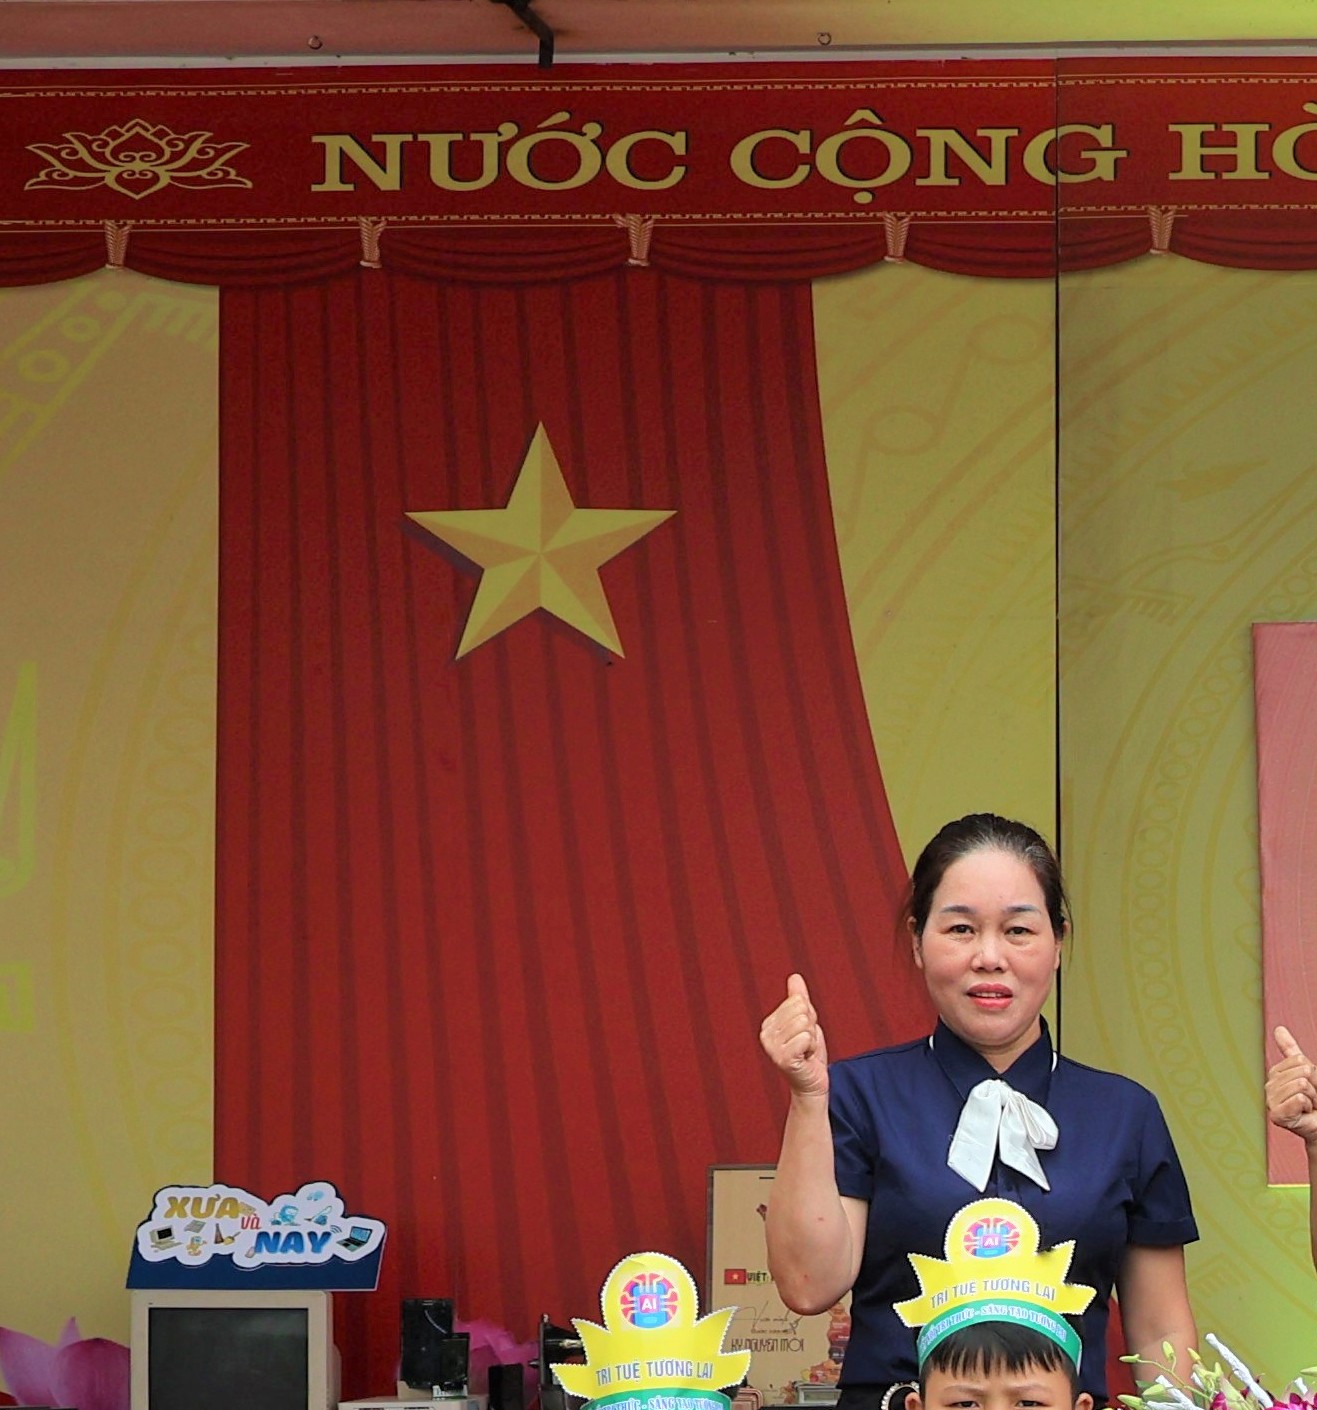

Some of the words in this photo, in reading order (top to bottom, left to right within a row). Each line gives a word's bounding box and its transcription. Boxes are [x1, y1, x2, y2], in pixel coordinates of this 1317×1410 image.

[310, 111, 690, 192] NƯỚC
[728, 108, 1128, 204] CỘNG
[164, 1194, 240, 1219] XƯA
[240, 1214, 262, 1230] và
[253, 1231, 332, 1254] NAY
[984, 1236, 1000, 1247] AI
[1035, 1283, 1056, 1302] LAI
[641, 1298, 658, 1311] AI
[697, 1362, 713, 1379] LAI
